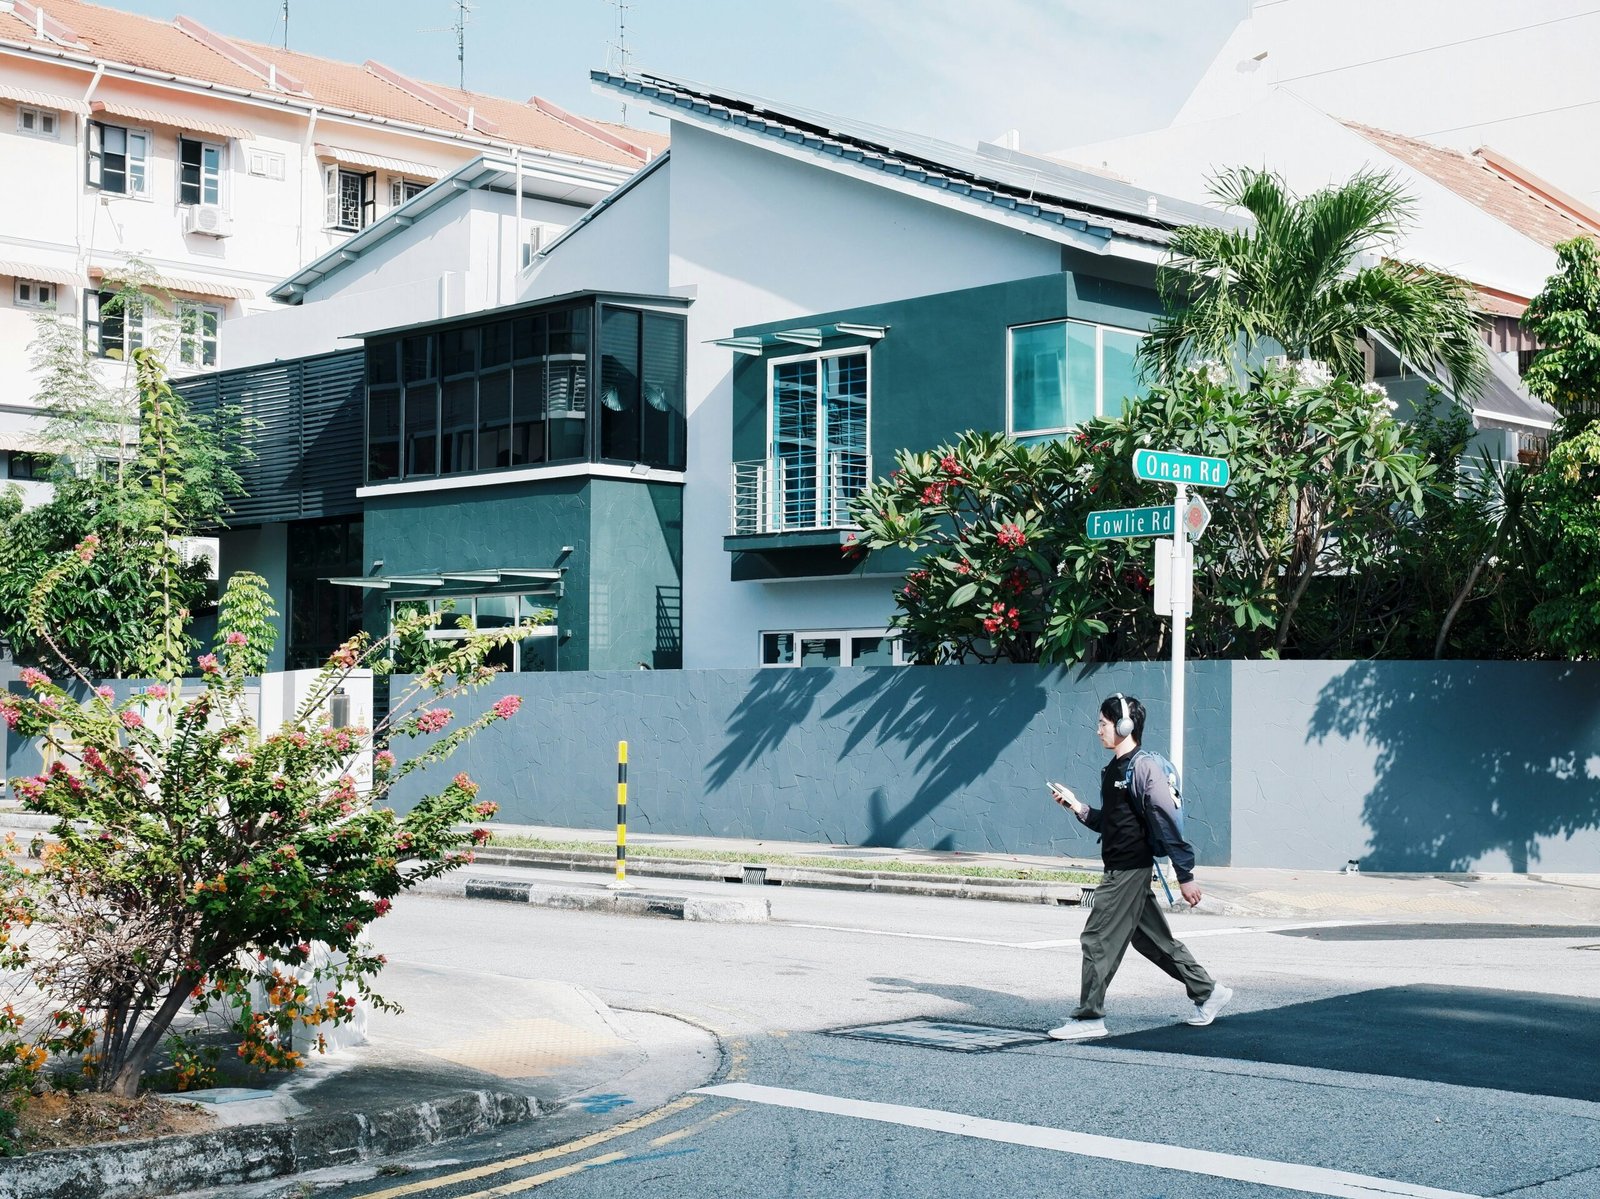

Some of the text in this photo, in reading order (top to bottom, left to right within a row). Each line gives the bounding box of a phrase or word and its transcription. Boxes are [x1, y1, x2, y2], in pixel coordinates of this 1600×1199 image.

[1146, 455, 1221, 483] Onan Rd
[1094, 510, 1170, 535] Fowlie Rd
